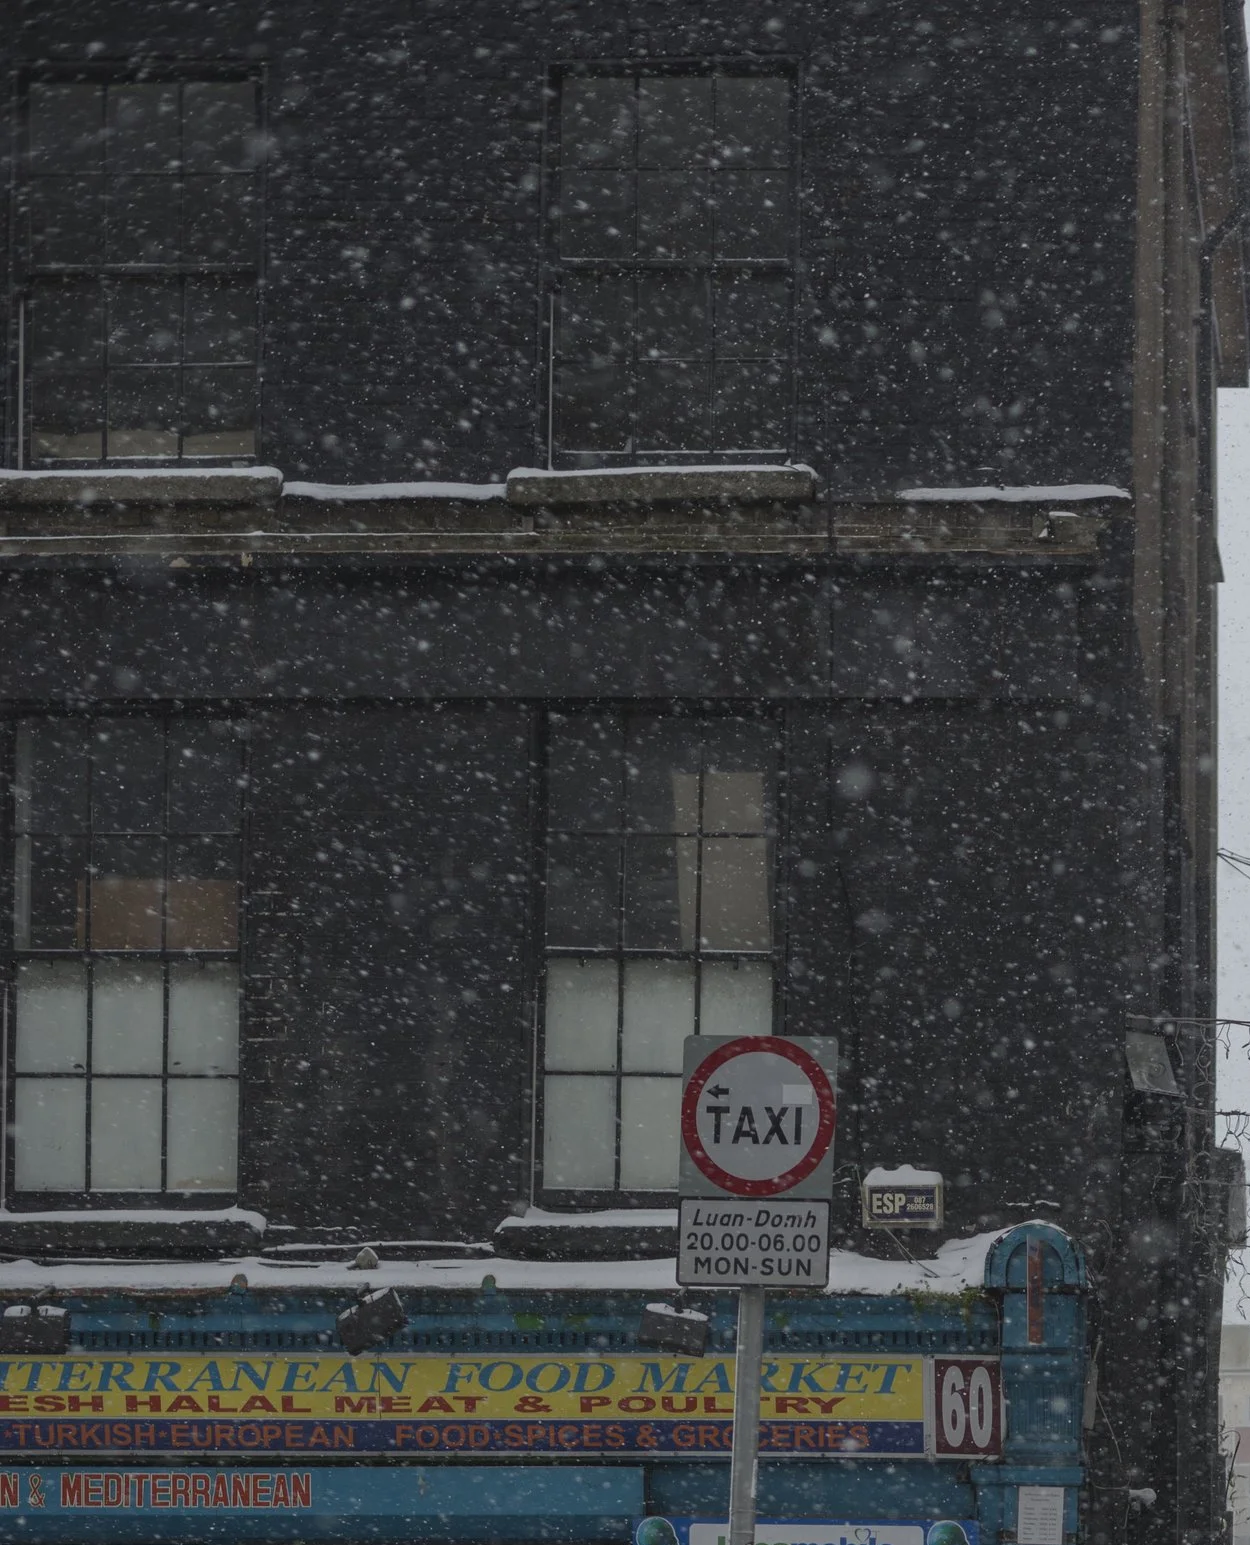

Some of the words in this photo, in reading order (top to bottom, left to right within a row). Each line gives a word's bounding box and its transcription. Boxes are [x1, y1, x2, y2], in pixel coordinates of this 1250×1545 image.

[706, 1106, 803, 1145] TAXI
[872, 1193, 906, 1214] ESP
[692, 1209, 817, 1229] Luan-Domh
[686, 1233, 821, 1253] 20.00-06.00
[694, 1257, 812, 1277] MON-SUN
[439, 1361, 615, 1393] FOOD
[632, 1362, 912, 1394] MARKET
[0, 1395, 104, 1413] ESH
[126, 1395, 311, 1413] HALAL
[335, 1395, 487, 1413] MEAT
[513, 1396, 552, 1413] &
[580, 1396, 846, 1414] POULRY
[942, 1365, 994, 1448] 60
[12, 1424, 155, 1447] TURKISH
[171, 1424, 355, 1448] EUROPEAN
[396, 1424, 490, 1448] FOOD
[503, 1424, 625, 1448] SPICES
[635, 1424, 656, 1448] &
[0, 1472, 19, 1508] N
[28, 1473, 46, 1508] &
[60, 1472, 312, 1509] MEDITERRANEAN
